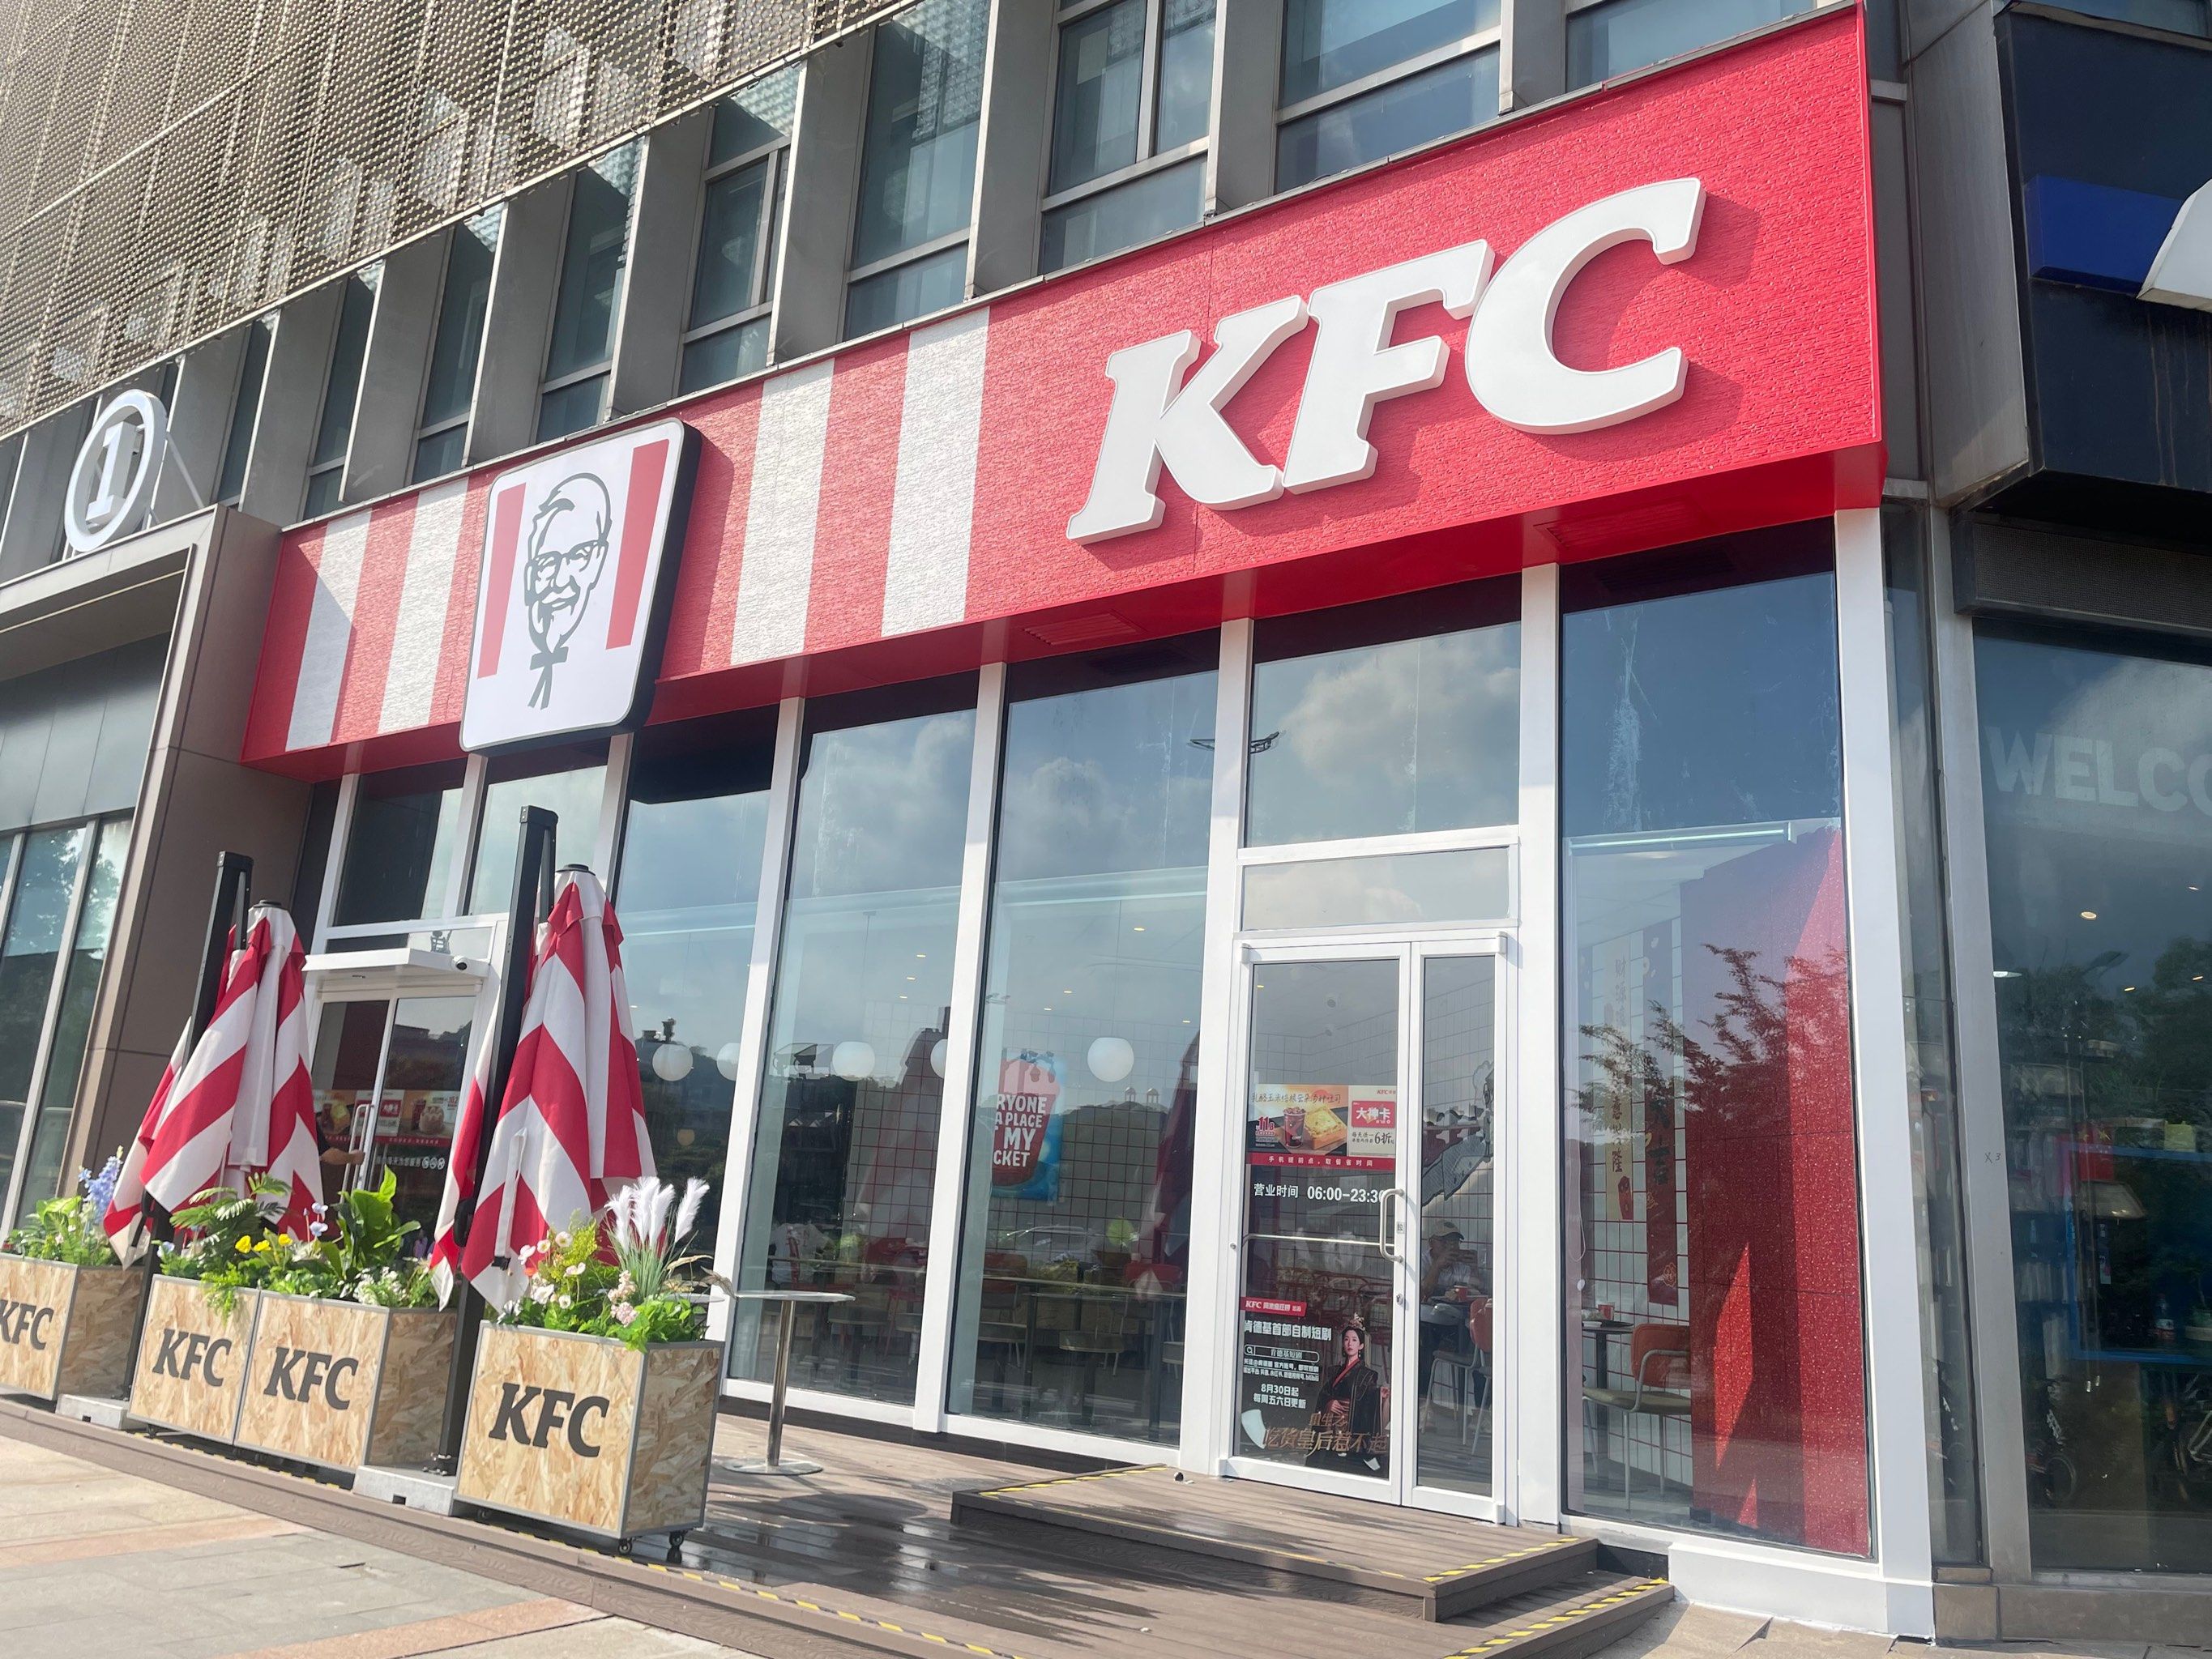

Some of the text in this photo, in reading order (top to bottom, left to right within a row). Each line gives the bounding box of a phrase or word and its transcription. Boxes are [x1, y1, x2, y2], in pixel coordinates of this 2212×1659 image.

[1065, 177, 1706, 544] KFC
[1005, 1112, 1043, 1128] PLACE
[1004, 1127, 1036, 1150] MY
[993, 1150, 1030, 1166] CKET
[1253, 1183, 1299, 1198] 营业时间
[1245, 1300, 1262, 1309] KFC
[0, 1301, 53, 1350] KFC
[1244, 1319, 1332, 1341] 肯德基首部自制短剧
[152, 1328, 233, 1388] KFC
[263, 1346, 359, 1410] KFC
[1253, 1392, 1307, 1410] 每周五六日更新
[1261, 1384, 1300, 1397] 8月30日起
[489, 1382, 610, 1458] KFC
